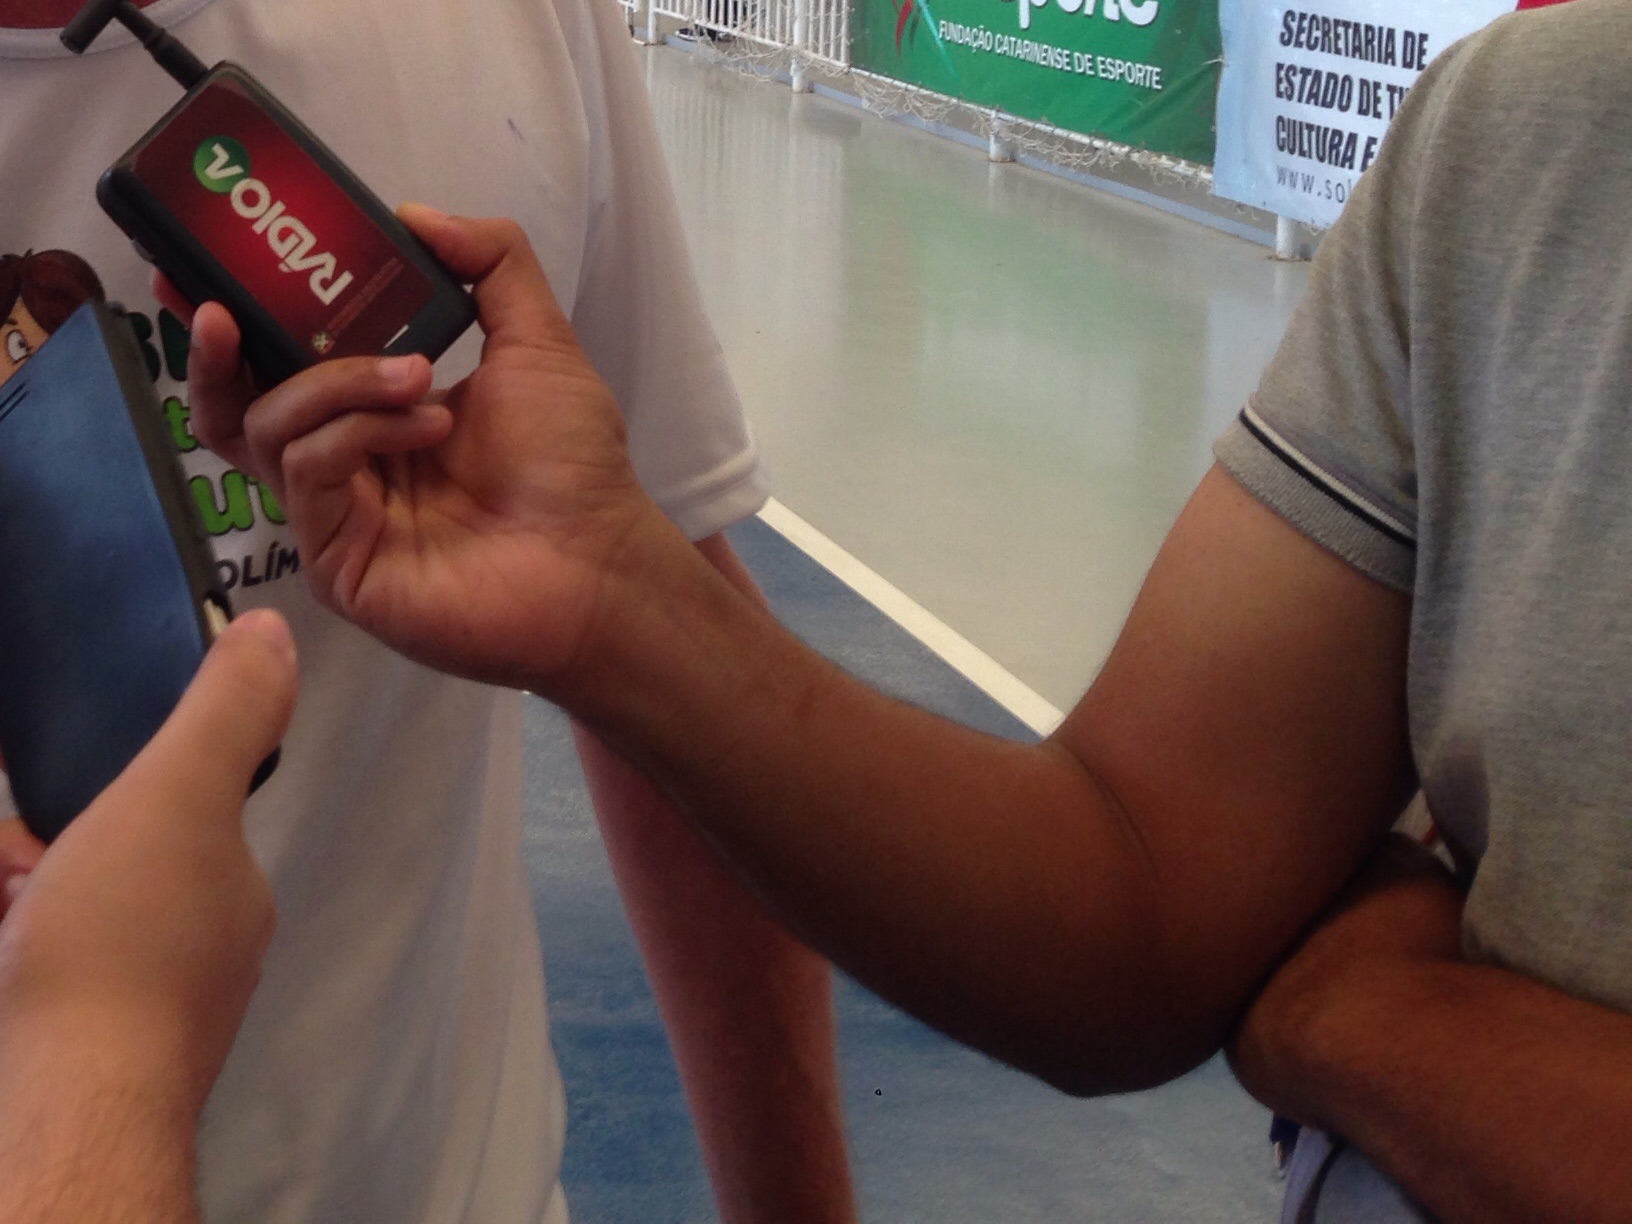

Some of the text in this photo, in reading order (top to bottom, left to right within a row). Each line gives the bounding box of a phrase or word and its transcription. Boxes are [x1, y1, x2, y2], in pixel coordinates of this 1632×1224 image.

[938, 20, 1162, 89] FUNDAÇÃO CATARINENSE DE ESPORTE
[1280, 9, 1429, 72] SECRETARIA DE
[1275, 62, 1353, 112] ESTADO
[1357, 78, 1382, 119] DE
[1275, 115, 1358, 170] CULTURA
